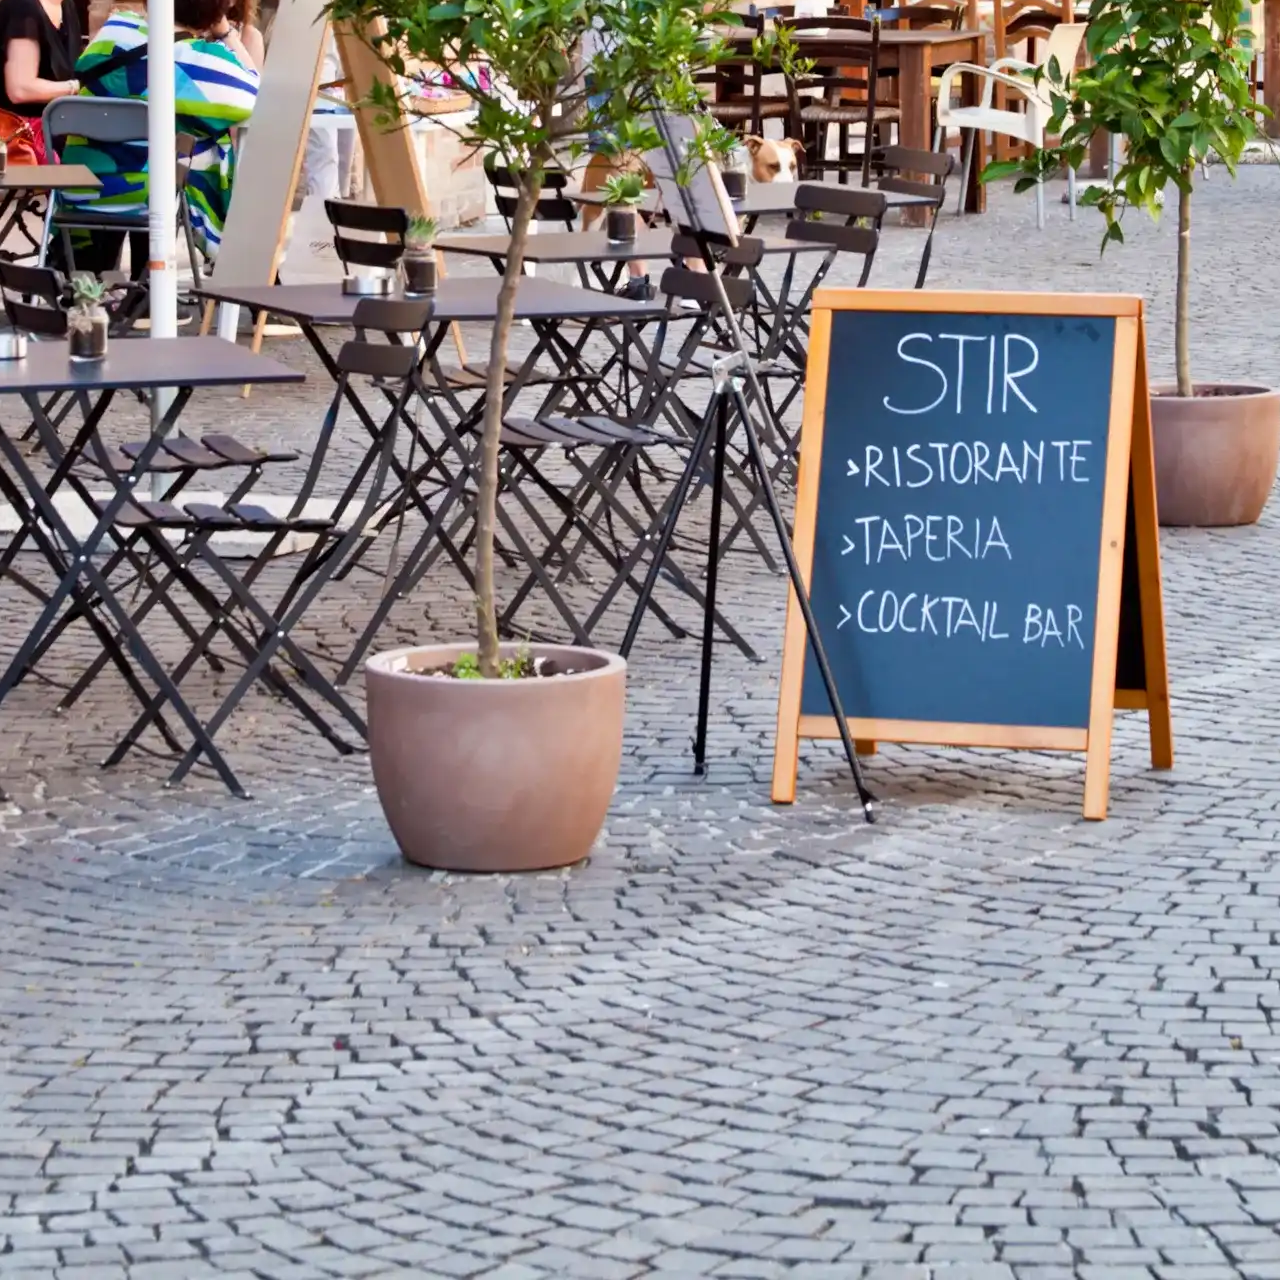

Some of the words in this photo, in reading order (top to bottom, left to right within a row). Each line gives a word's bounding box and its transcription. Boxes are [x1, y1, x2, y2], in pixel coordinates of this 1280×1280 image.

[882, 332, 1040, 416] STIR
[863, 439, 1093, 489] RISTORANTE
[854, 514, 1013, 565] TAPERIA
[856, 588, 1010, 643] COCKTAIL
[1022, 602, 1086, 651] BAR
